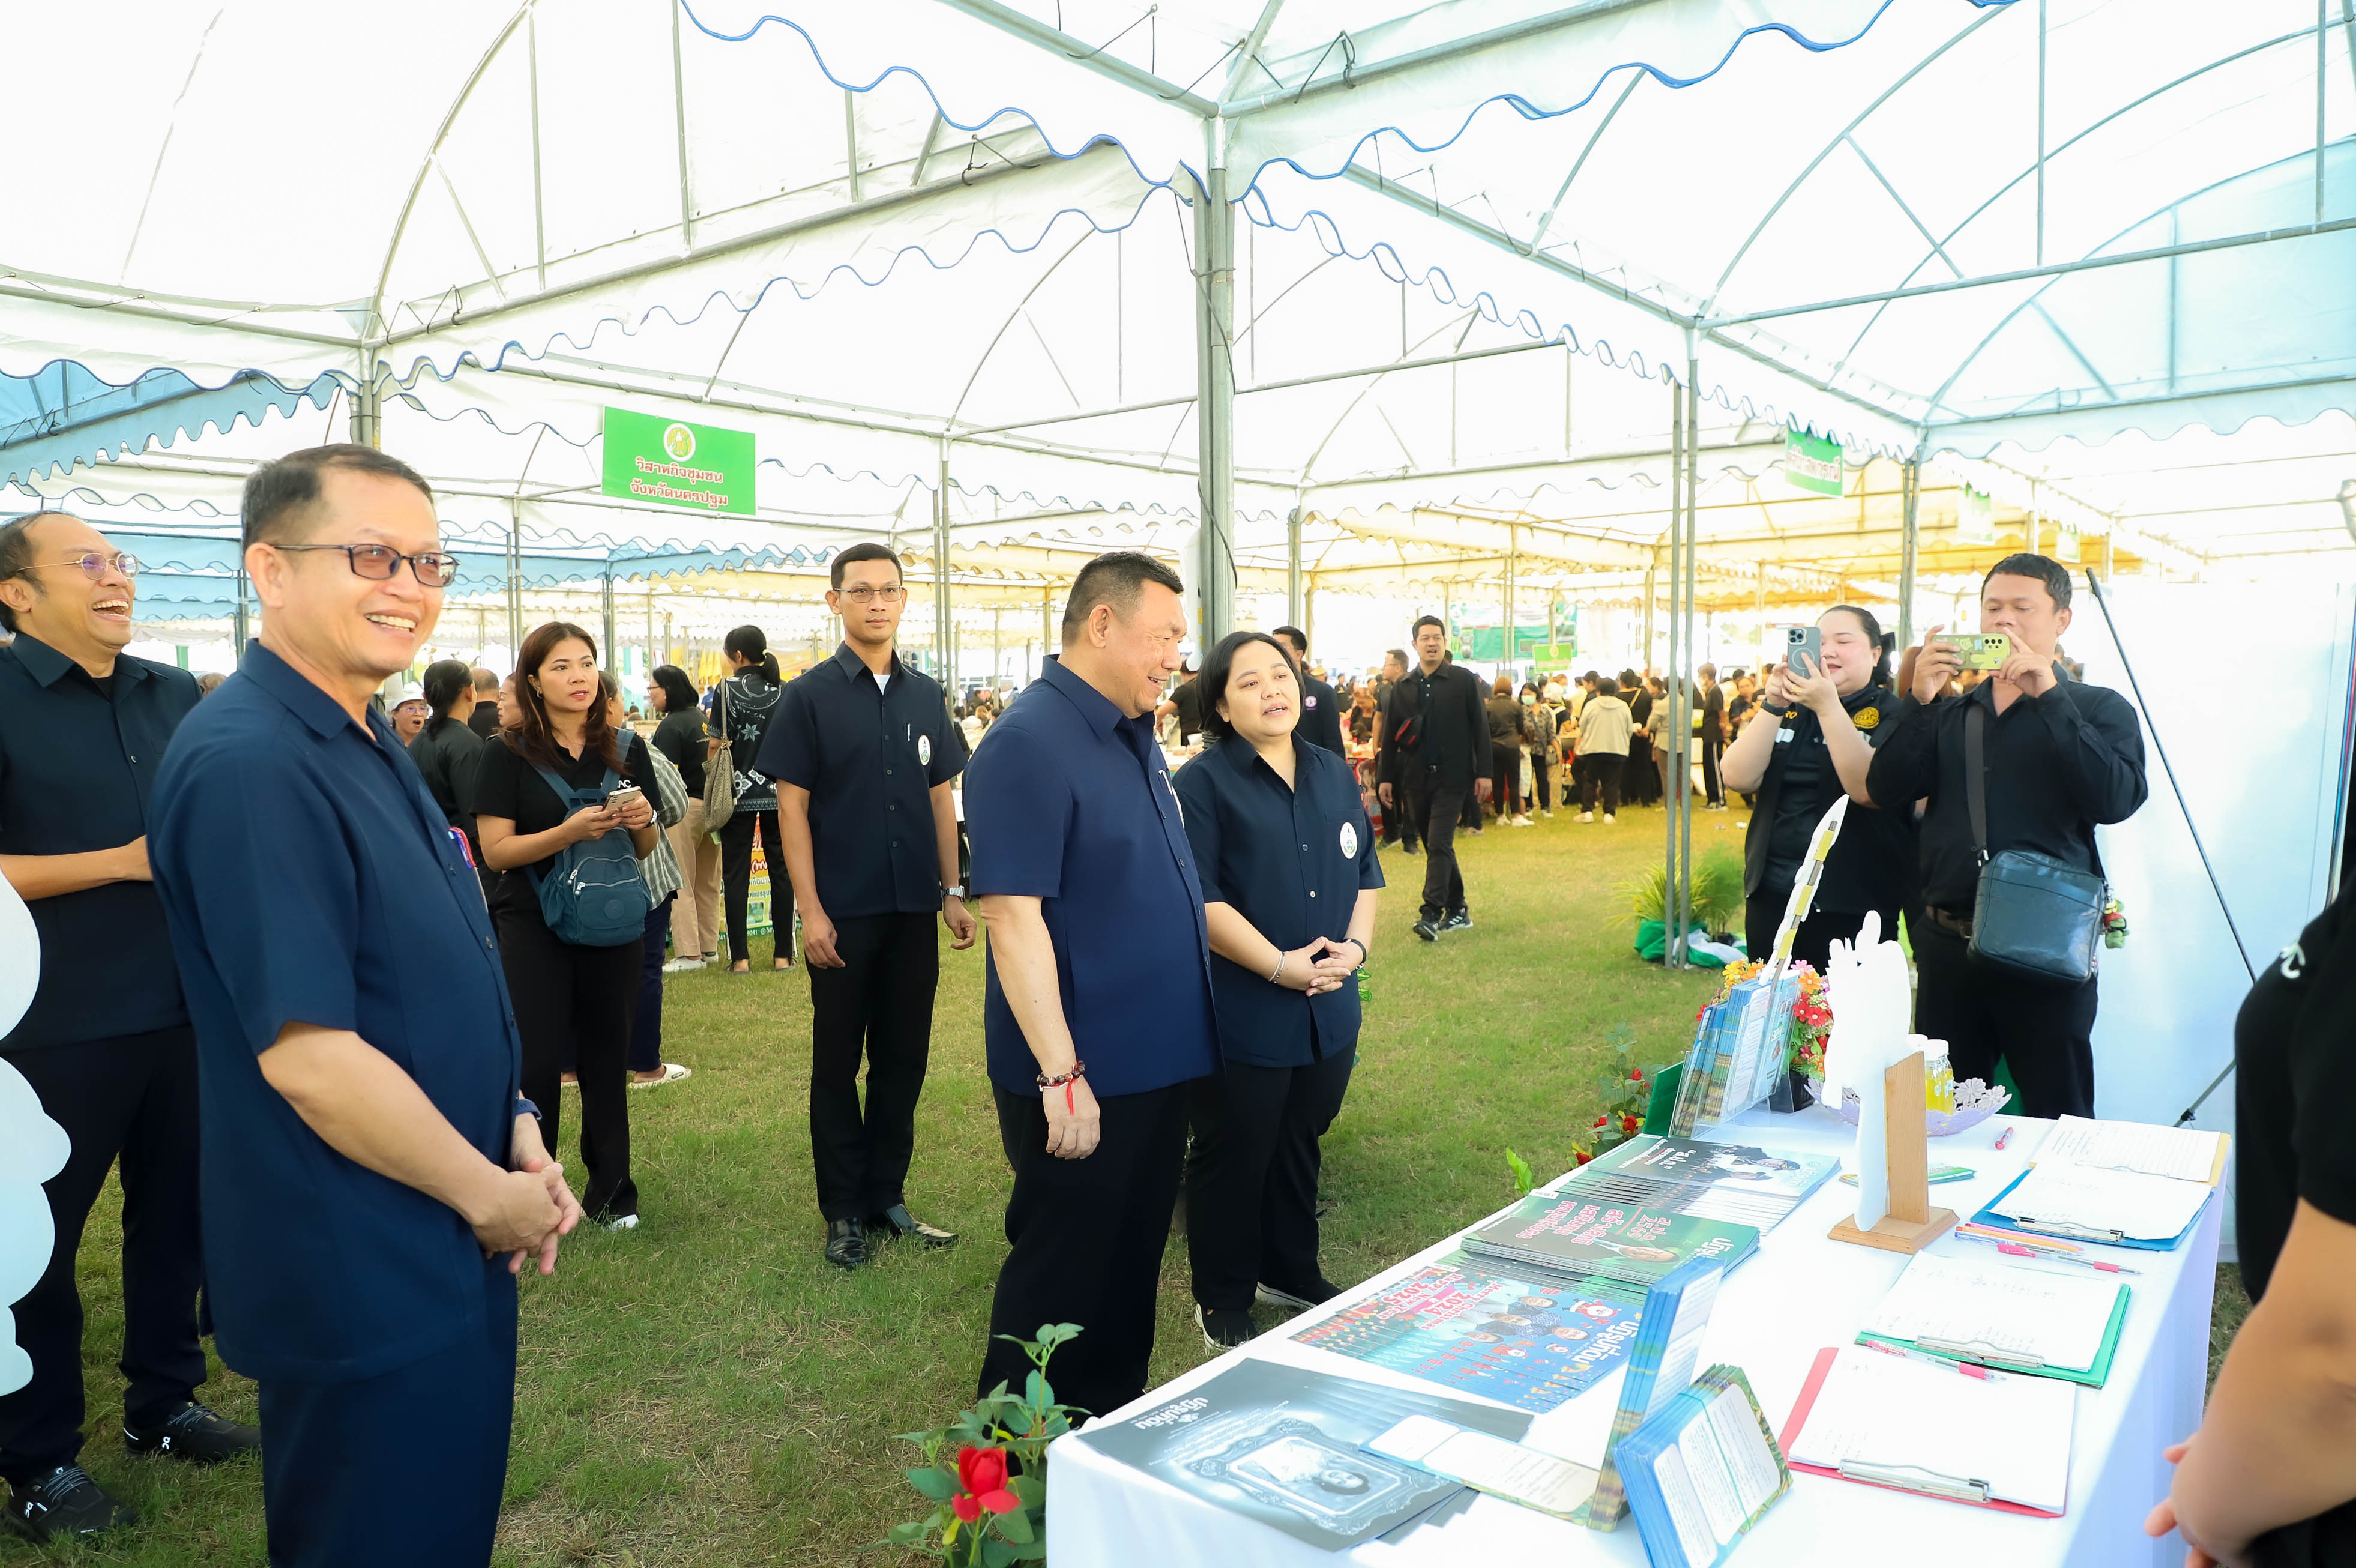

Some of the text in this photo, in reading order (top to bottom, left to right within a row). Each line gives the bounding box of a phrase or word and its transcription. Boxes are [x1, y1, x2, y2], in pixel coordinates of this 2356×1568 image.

[636, 457, 723, 484] วิสาหกิจชุมชน
[630, 479, 728, 508] จังหวัดนครปฐม
[1626, 1214, 1659, 1238] 2569
[1376, 1273, 1465, 1320] Happy New Year
[1381, 1282, 1429, 1305] 2025
[1419, 1281, 1505, 1331] Merry Christmas
[1423, 1292, 1471, 1315] 2024
[1571, 1321, 1640, 1364] ปฏิรูปที่ดิน
